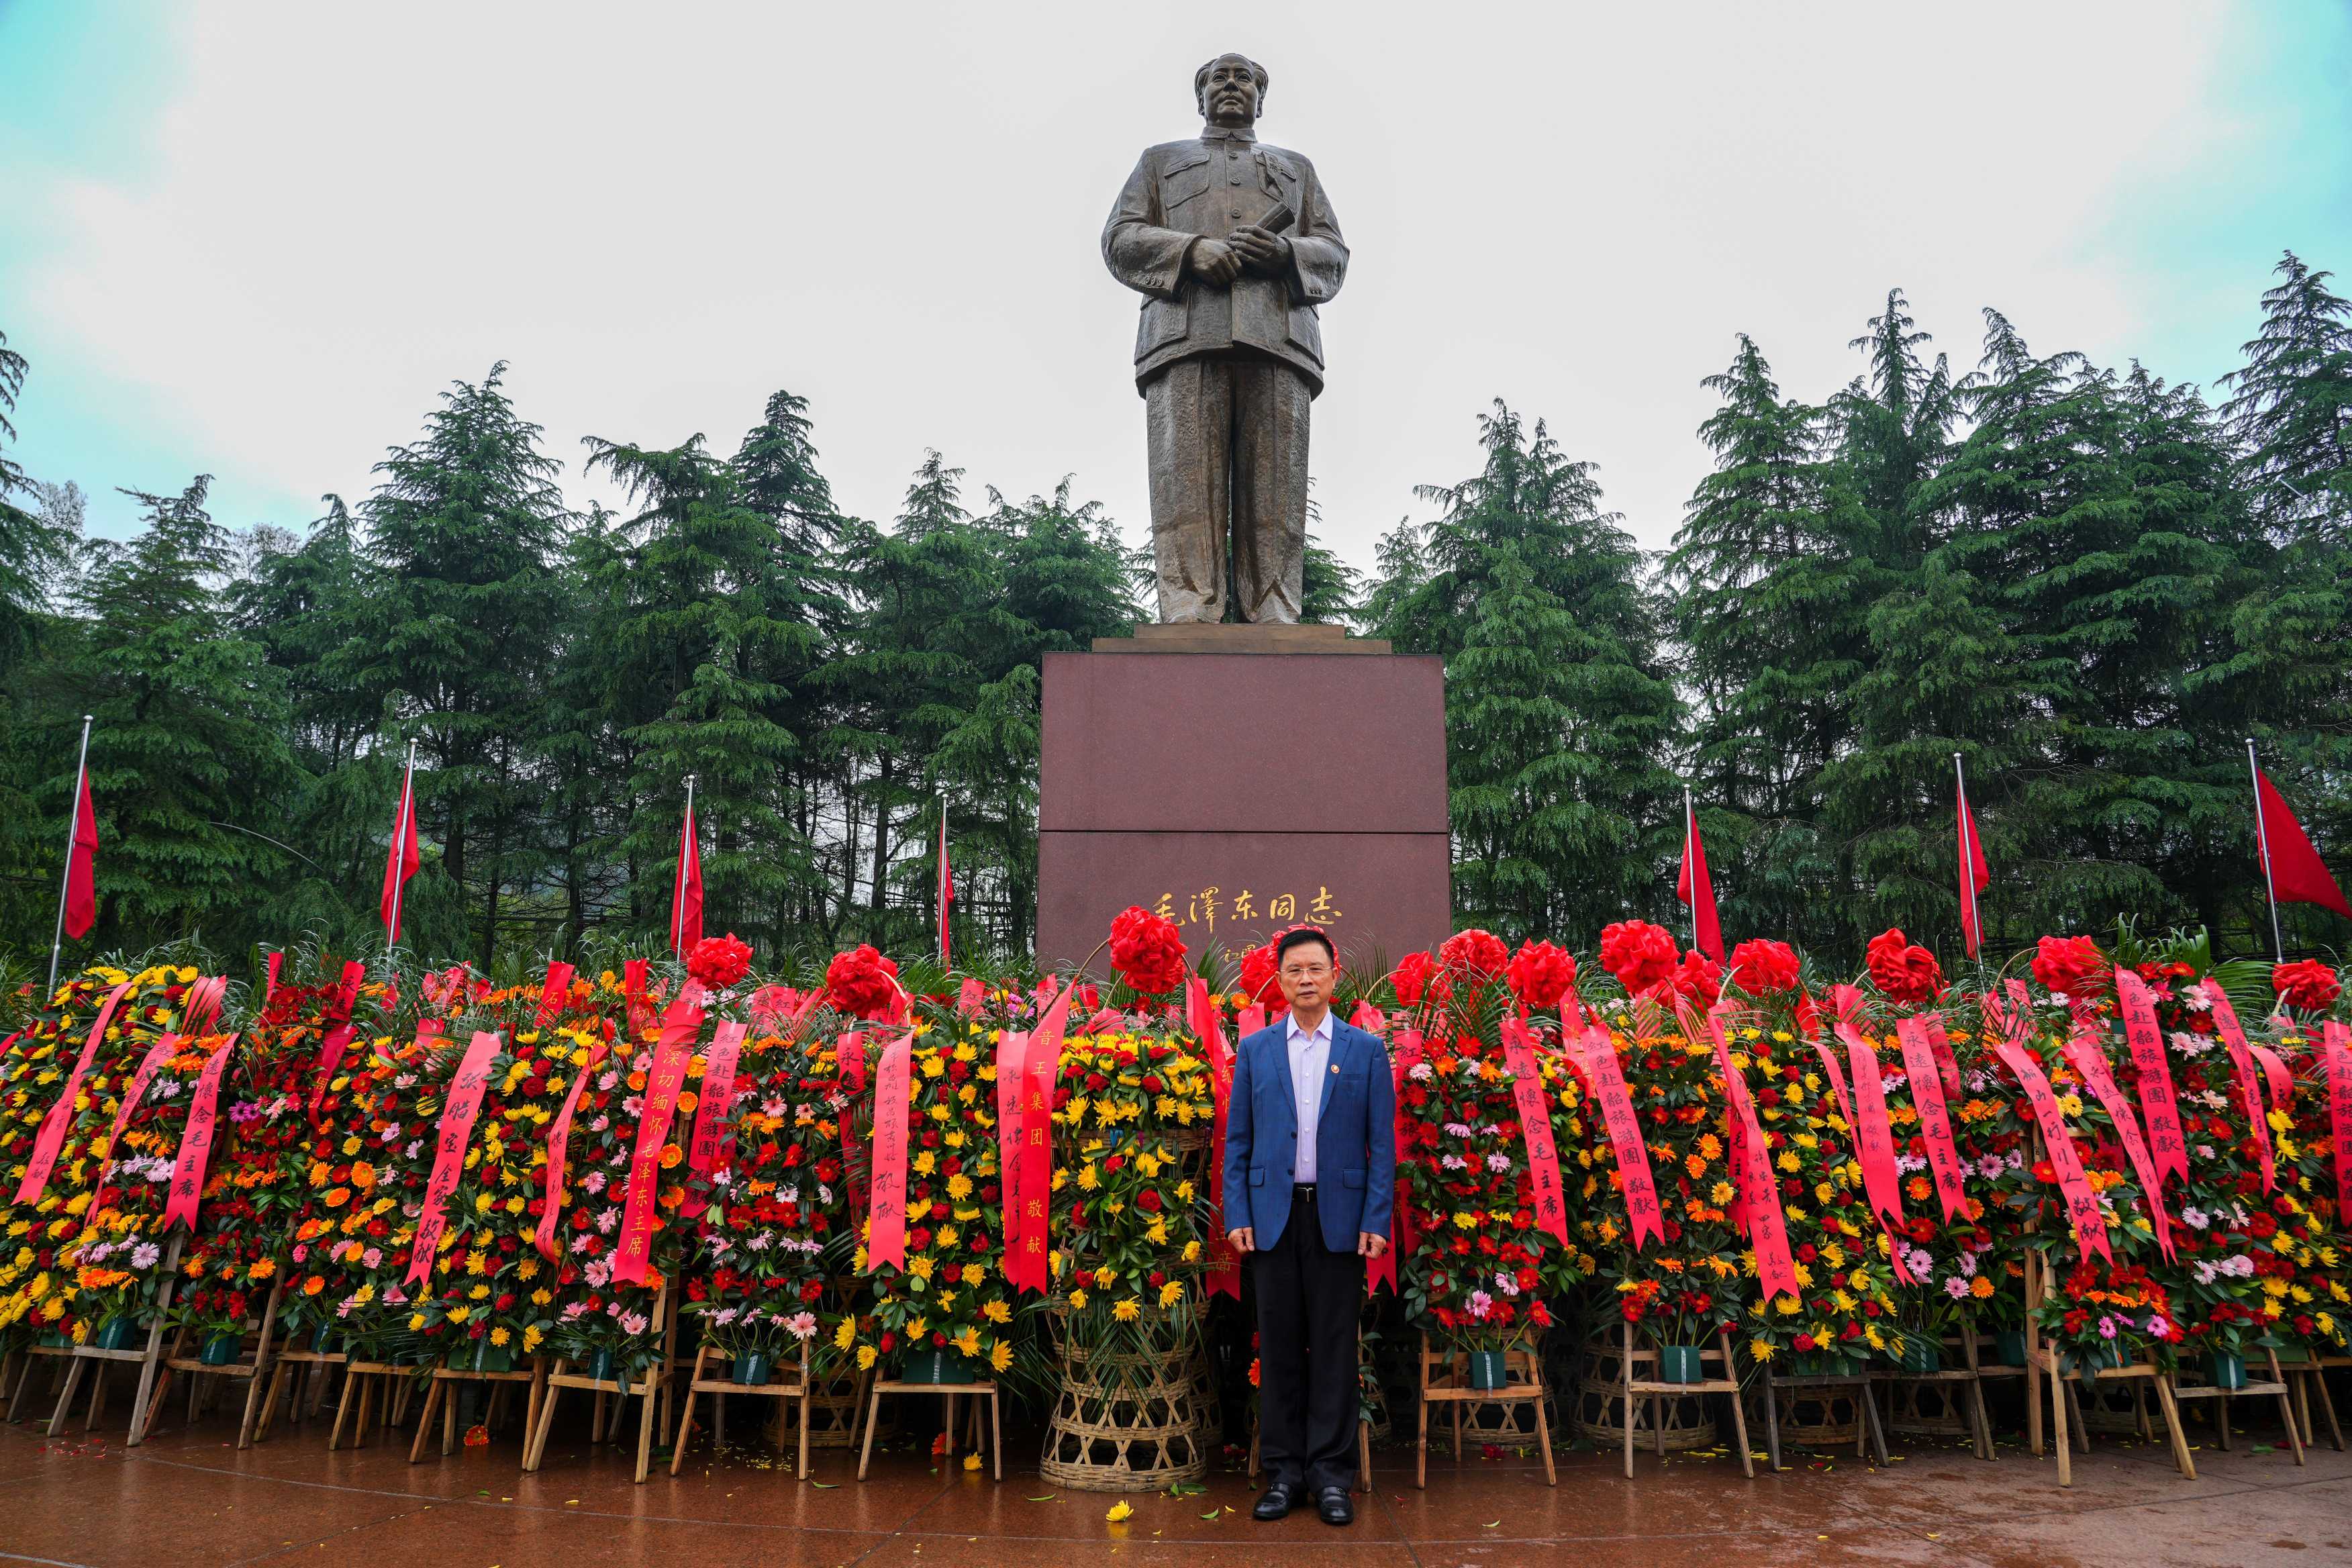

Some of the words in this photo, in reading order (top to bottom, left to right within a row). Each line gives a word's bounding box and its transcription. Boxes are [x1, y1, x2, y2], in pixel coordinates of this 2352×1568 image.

[625, 1049, 683, 1257] 深切缅怀毛泽东主席
[1030, 1029, 1055, 1146] 音王集团
[1508, 1036, 1558, 1218] 永遠懷念毛主席
[1906, 1031, 1957, 1192] 永遠懷念毛主席
[1026, 1199, 1043, 1254] 敬献
